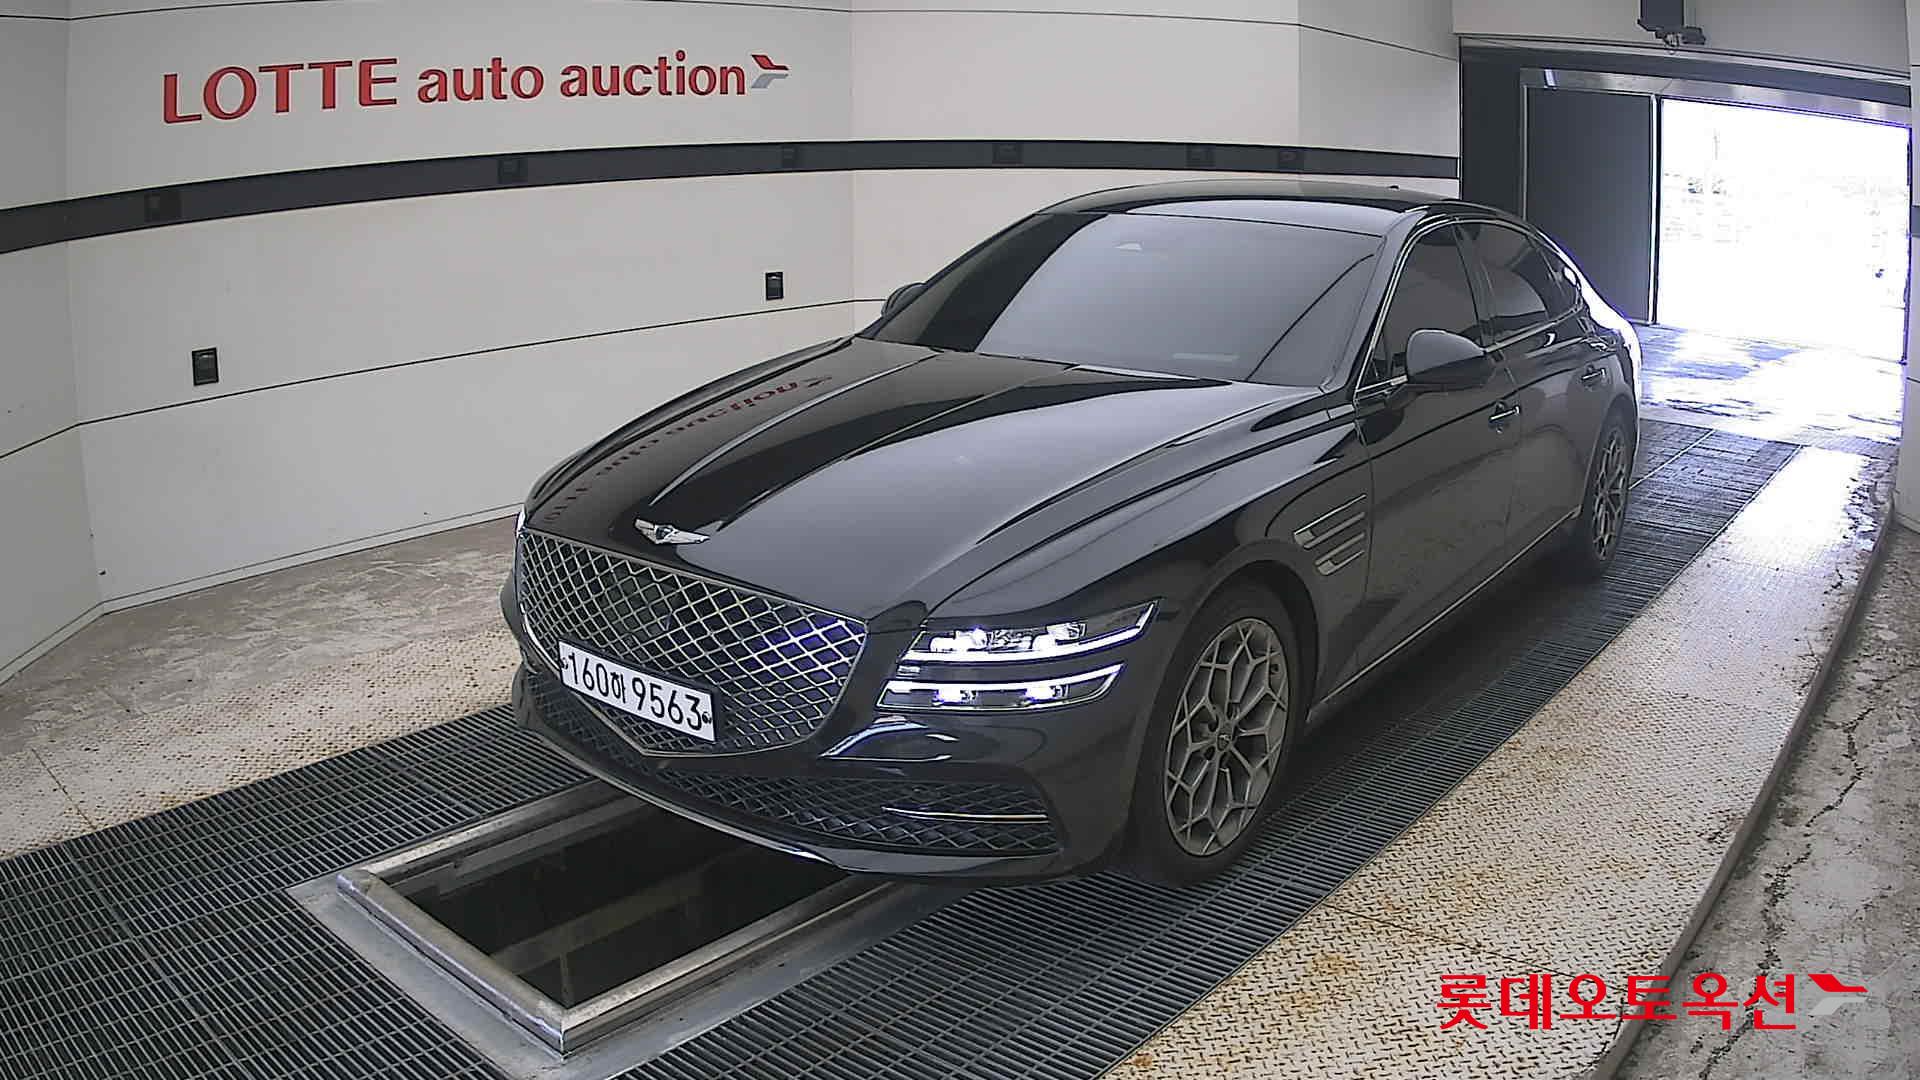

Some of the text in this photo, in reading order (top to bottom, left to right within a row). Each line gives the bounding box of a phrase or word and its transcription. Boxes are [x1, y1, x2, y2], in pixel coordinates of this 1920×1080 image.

[163, 50, 745, 124] LOTTE auto auction
[569, 652, 702, 731] 160하 9563
